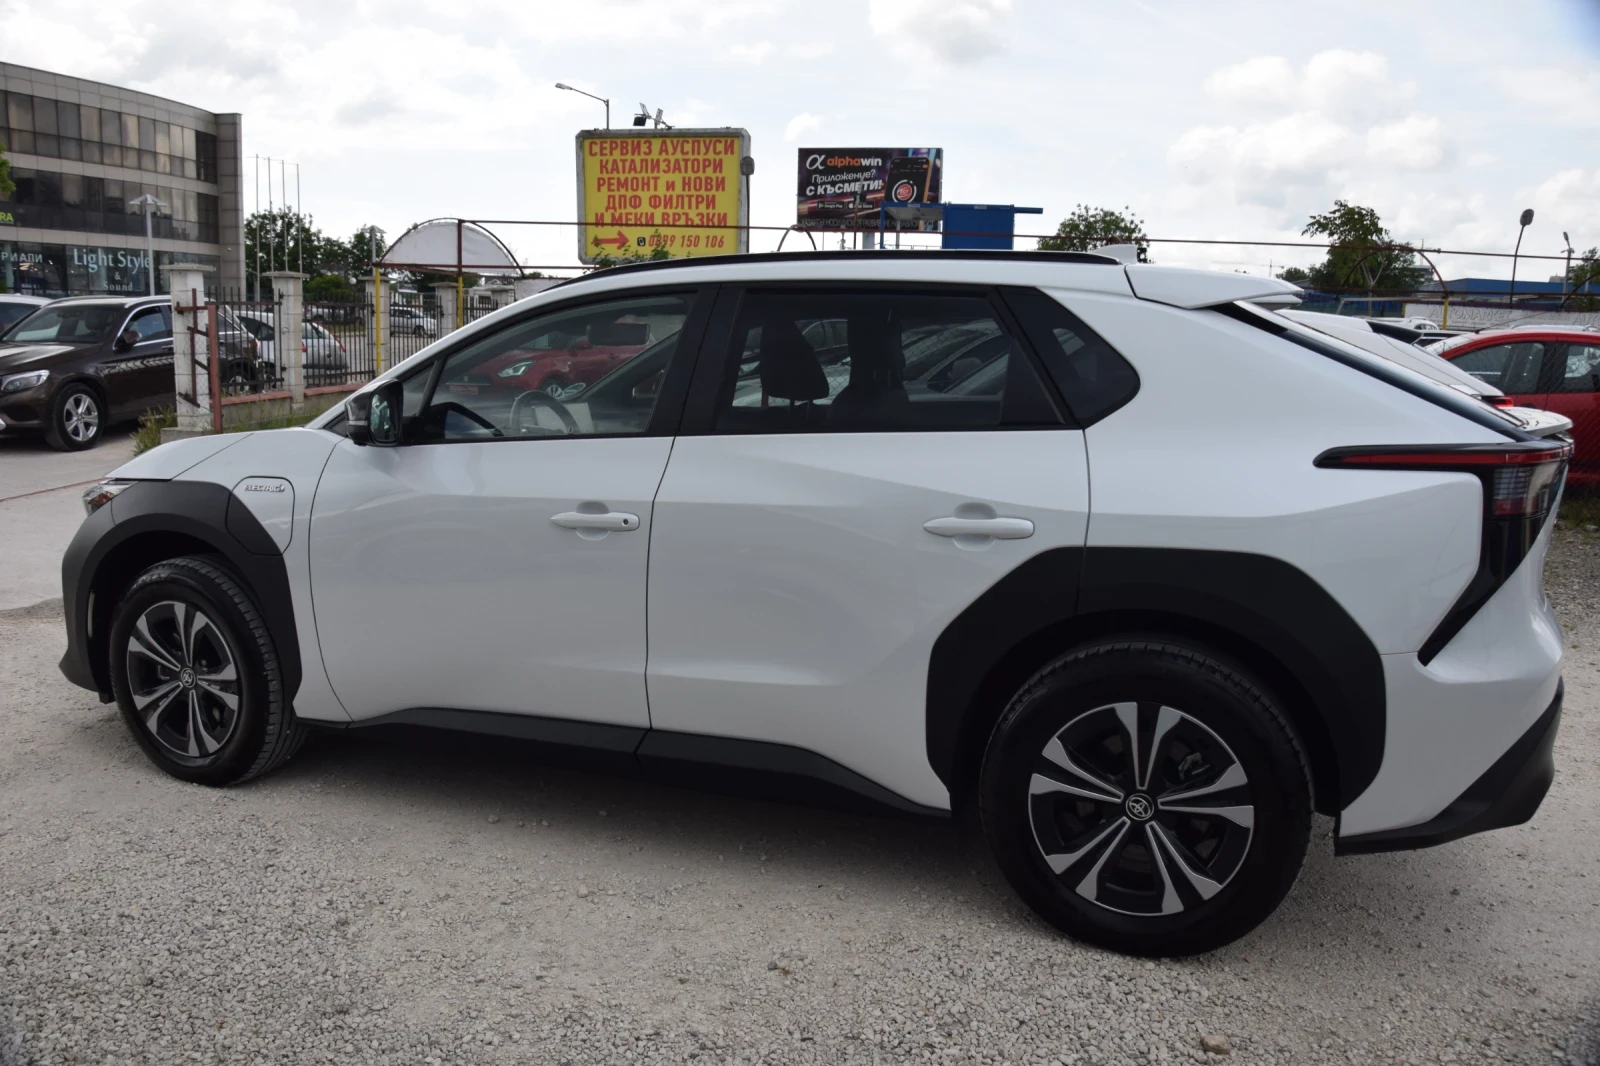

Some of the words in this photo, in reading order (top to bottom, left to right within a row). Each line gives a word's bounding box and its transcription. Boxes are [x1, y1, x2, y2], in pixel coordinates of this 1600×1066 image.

[588, 140, 653, 157] СЕРВИЗ
[658, 139, 736, 156] АУСПУСИ
[599, 158, 723, 174] КАТАЛИЗАТОРИ
[826, 156, 882, 168] alphawin
[597, 176, 660, 192] РЕМОНТ
[665, 180, 676, 192] и
[681, 176, 726, 192] НОВИ
[811, 169, 876, 184] Приложение?
[605, 194, 642, 212] ДПФ
[648, 194, 717, 211] ФИЛТРИ
[595, 212, 604, 228] И
[611, 212, 655, 228] МЕКИ
[661, 212, 728, 228] ВРЪЗКИ
[680, 235, 701, 247] 150
[705, 235, 725, 248] 106
[74, 249, 113, 273] Light
[117, 251, 150, 274] Style
[114, 272, 121, 280] &
[103, 282, 133, 291] Sound
